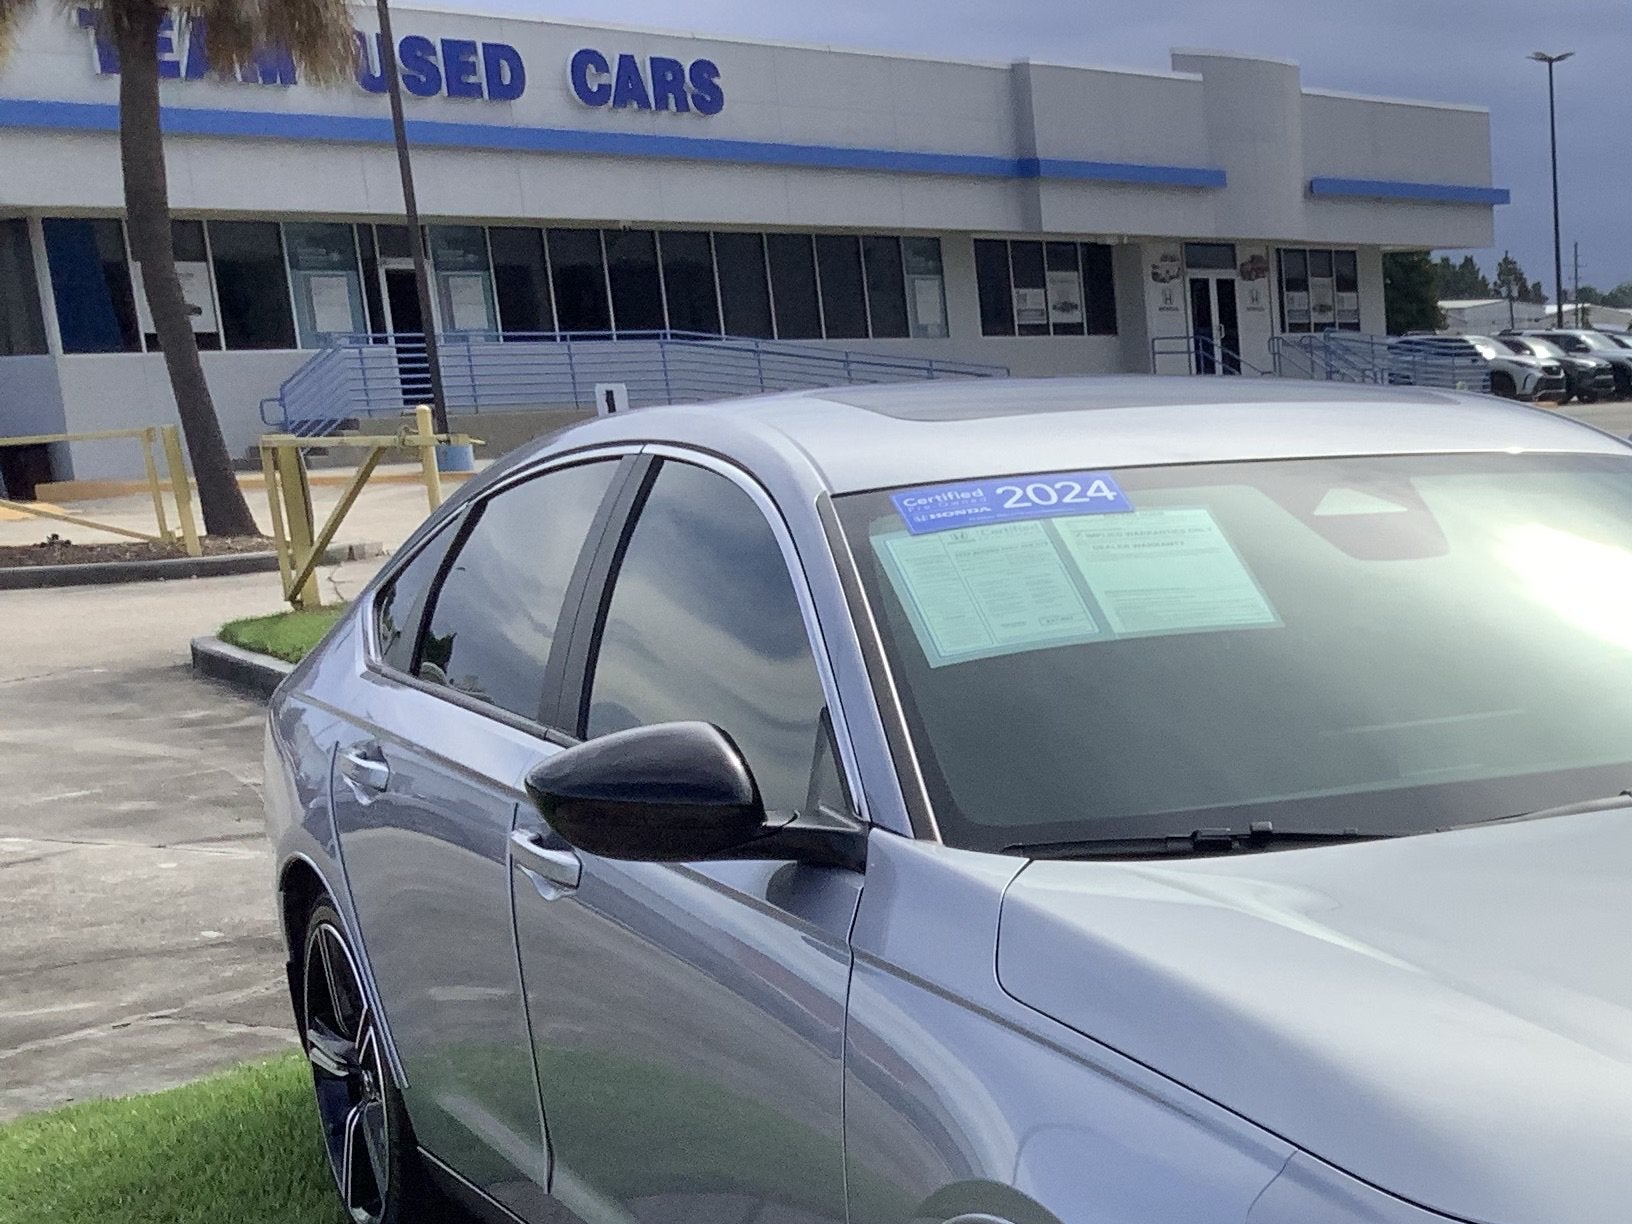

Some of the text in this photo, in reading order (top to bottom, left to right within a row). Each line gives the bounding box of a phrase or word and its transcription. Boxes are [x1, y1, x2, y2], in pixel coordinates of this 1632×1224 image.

[353, 29, 526, 101] USED
[570, 48, 725, 116] CARS
[903, 479, 1118, 509] Certified 2024
[929, 507, 992, 520] HONDA
